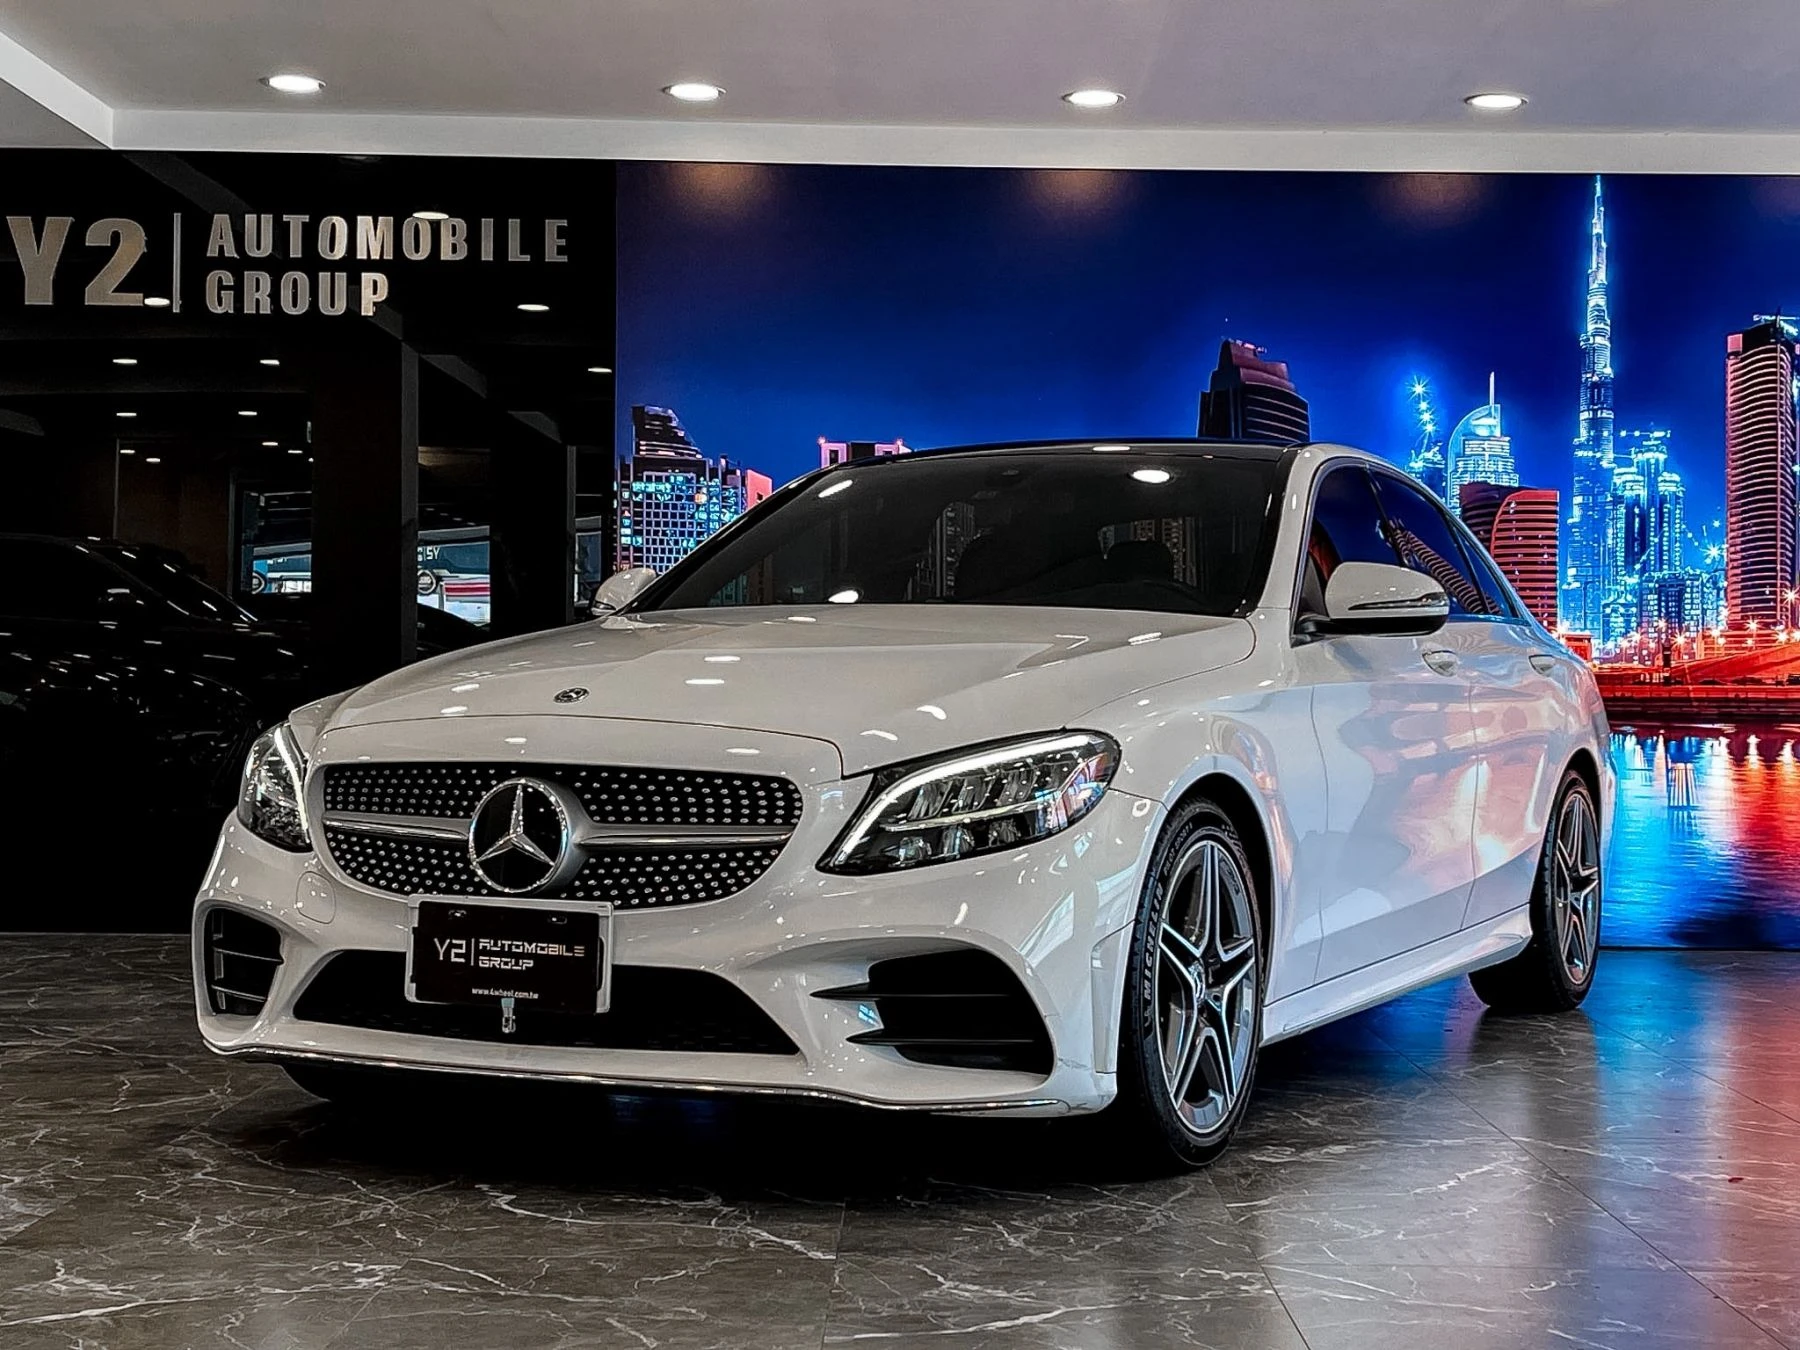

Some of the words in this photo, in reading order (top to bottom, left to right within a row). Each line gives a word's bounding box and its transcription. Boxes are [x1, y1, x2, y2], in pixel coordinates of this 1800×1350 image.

[206, 213, 569, 262] AUTOMOBILE
[6, 216, 147, 306] Y2
[206, 270, 389, 316] GROUP
[433, 937, 467, 963] Y2
[478, 938, 586, 957] AUTOMOBILE
[478, 956, 534, 970] GROUP
[1144, 882, 1164, 1000] MICHELIN
